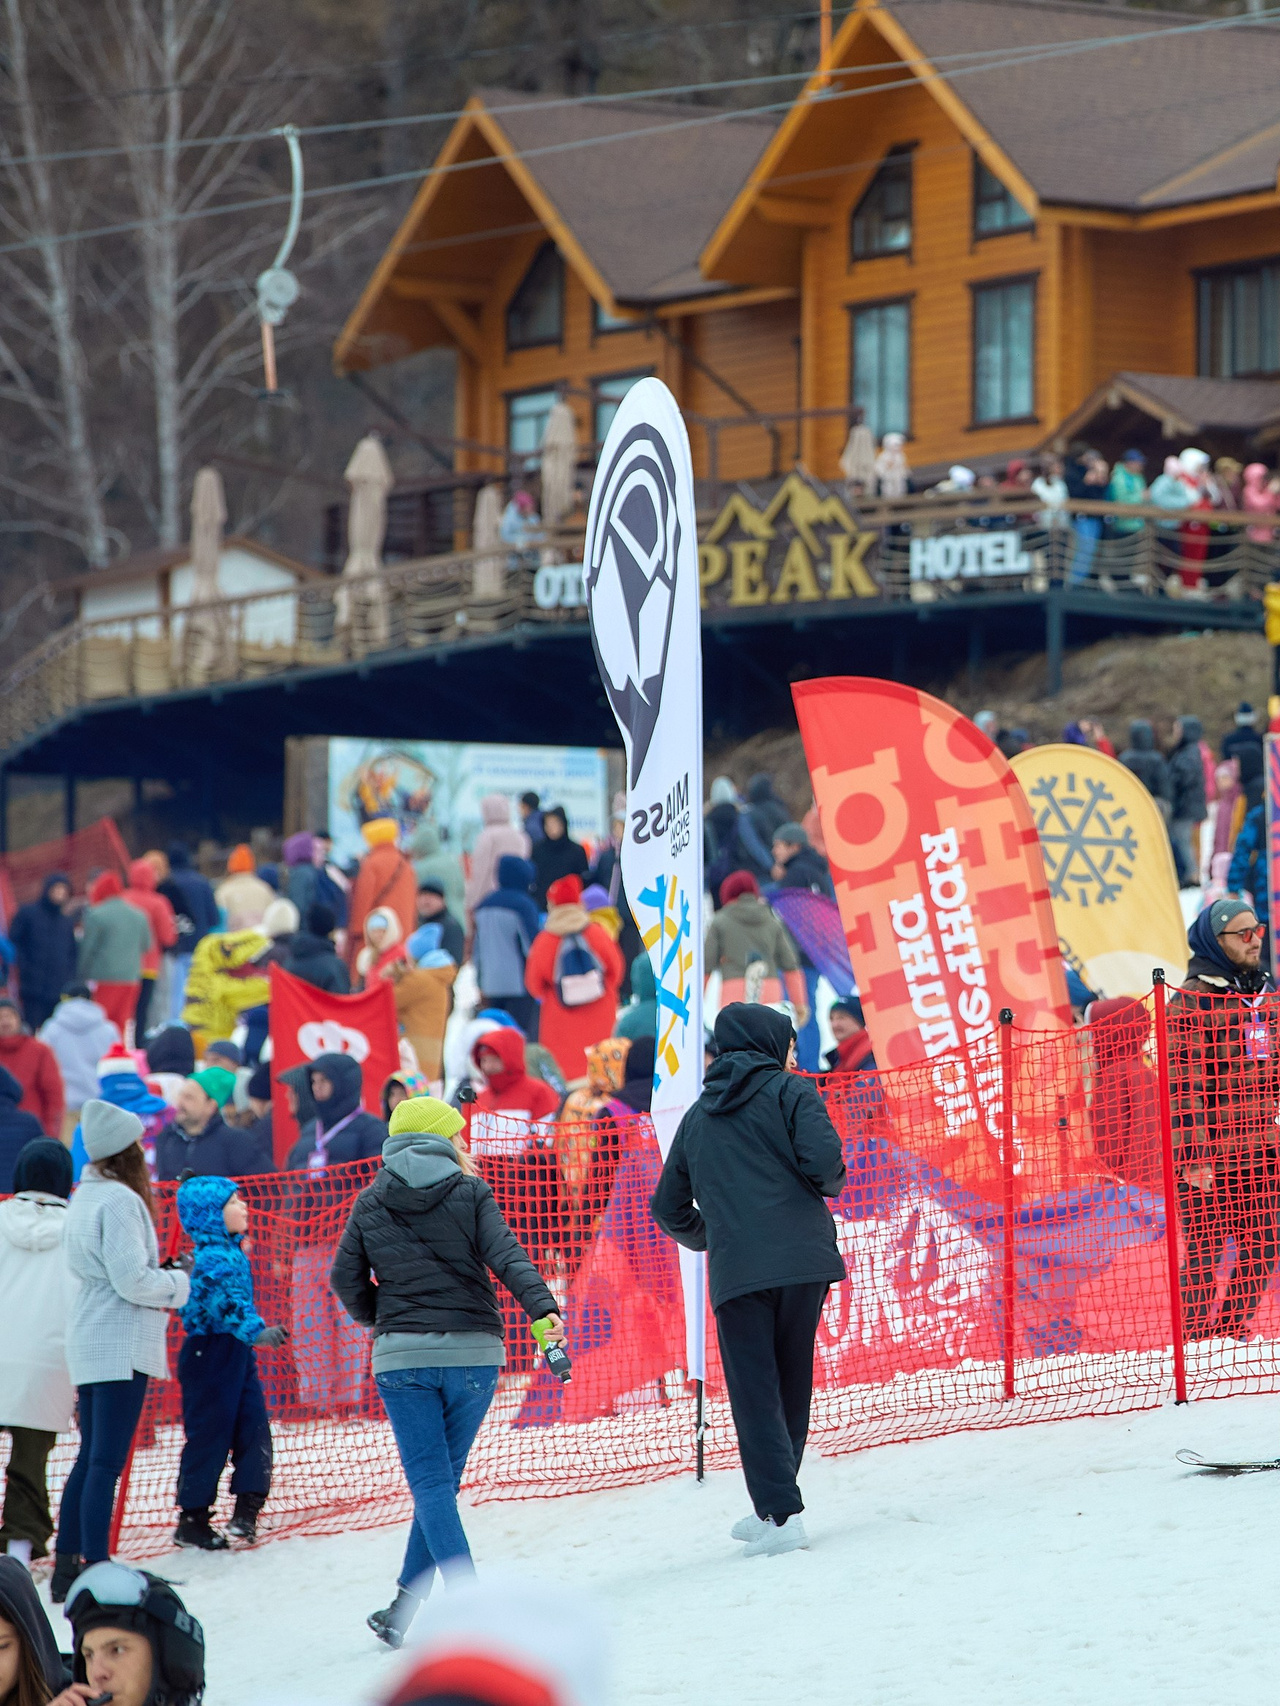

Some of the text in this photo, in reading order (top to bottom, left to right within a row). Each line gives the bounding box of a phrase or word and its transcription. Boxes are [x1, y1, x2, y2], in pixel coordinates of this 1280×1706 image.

[700, 532, 881, 608] PEAK
[910, 530, 1034, 581] HOTEL
[533, 564, 587, 609] ОТ
